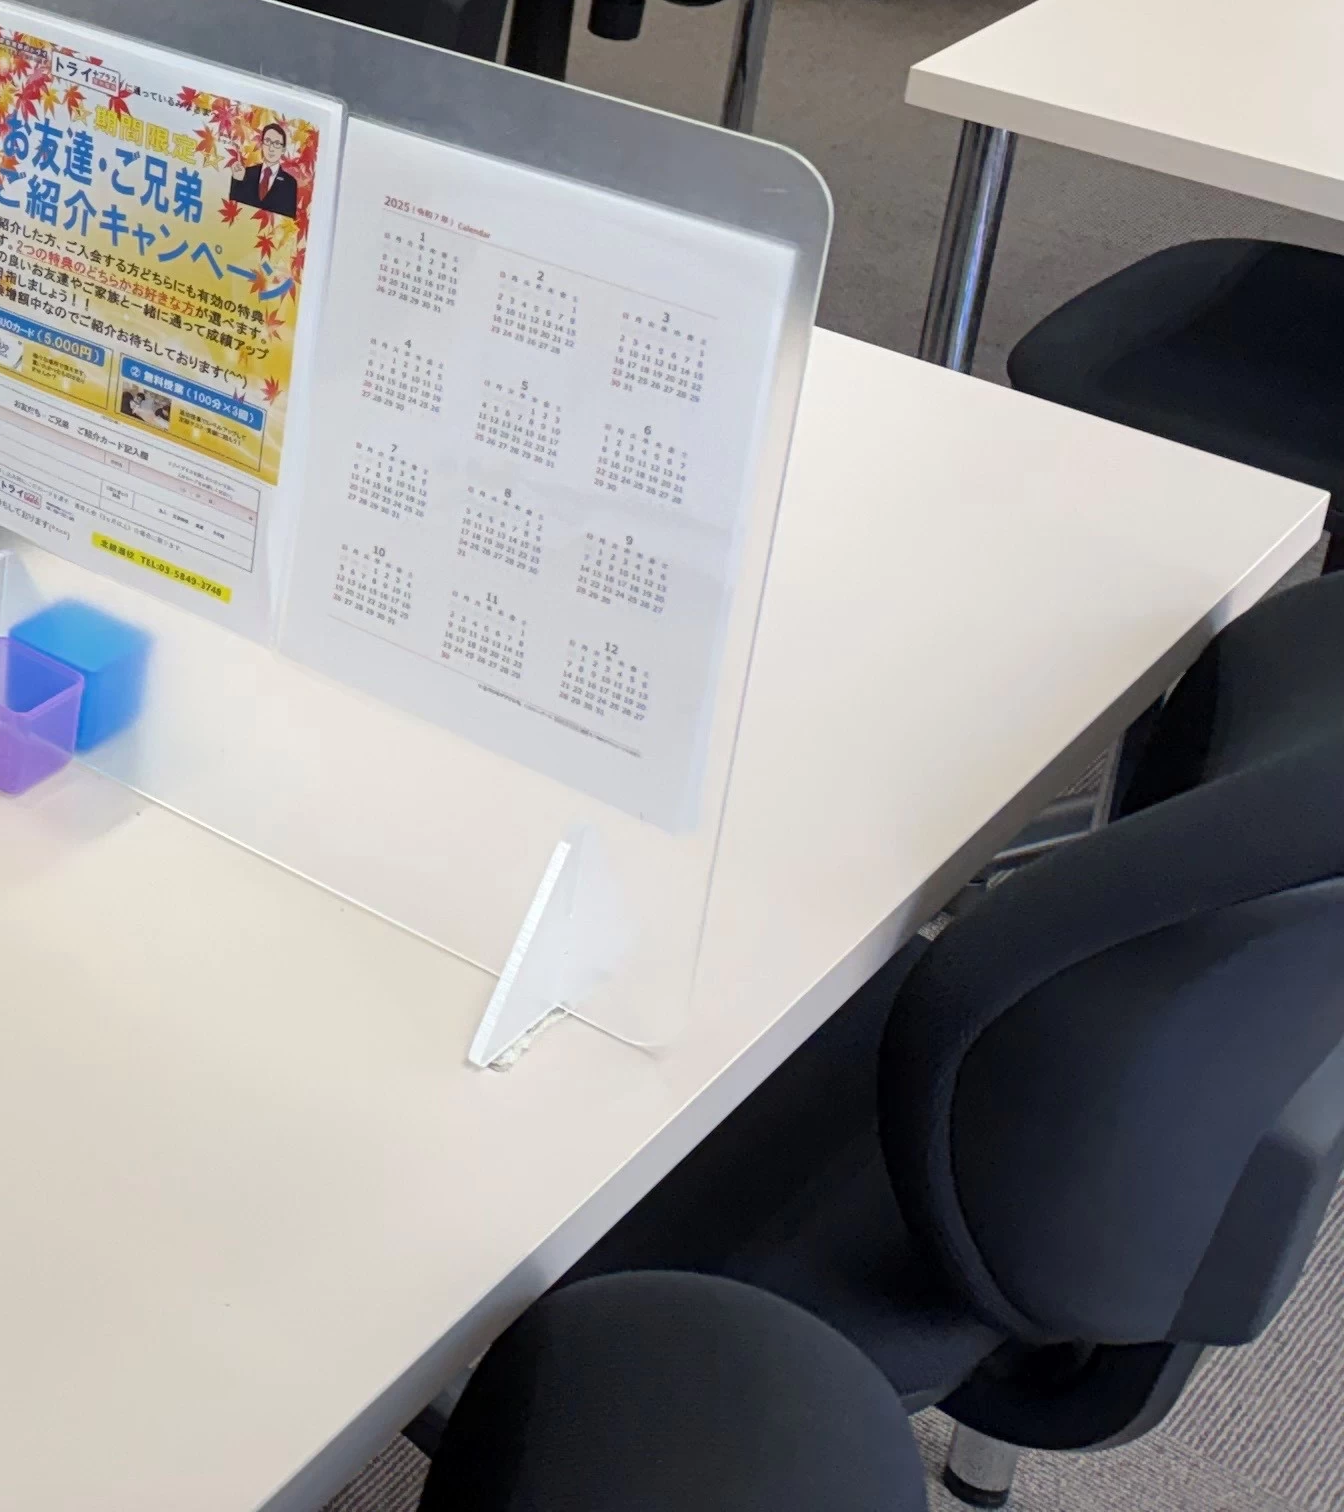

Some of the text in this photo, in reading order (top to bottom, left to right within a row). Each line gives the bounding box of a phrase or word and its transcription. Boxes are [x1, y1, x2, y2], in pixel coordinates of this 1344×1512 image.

[54, 56, 92, 83] トライ
[384, 195, 411, 213] 2025
[457, 221, 490, 239] Calendar
